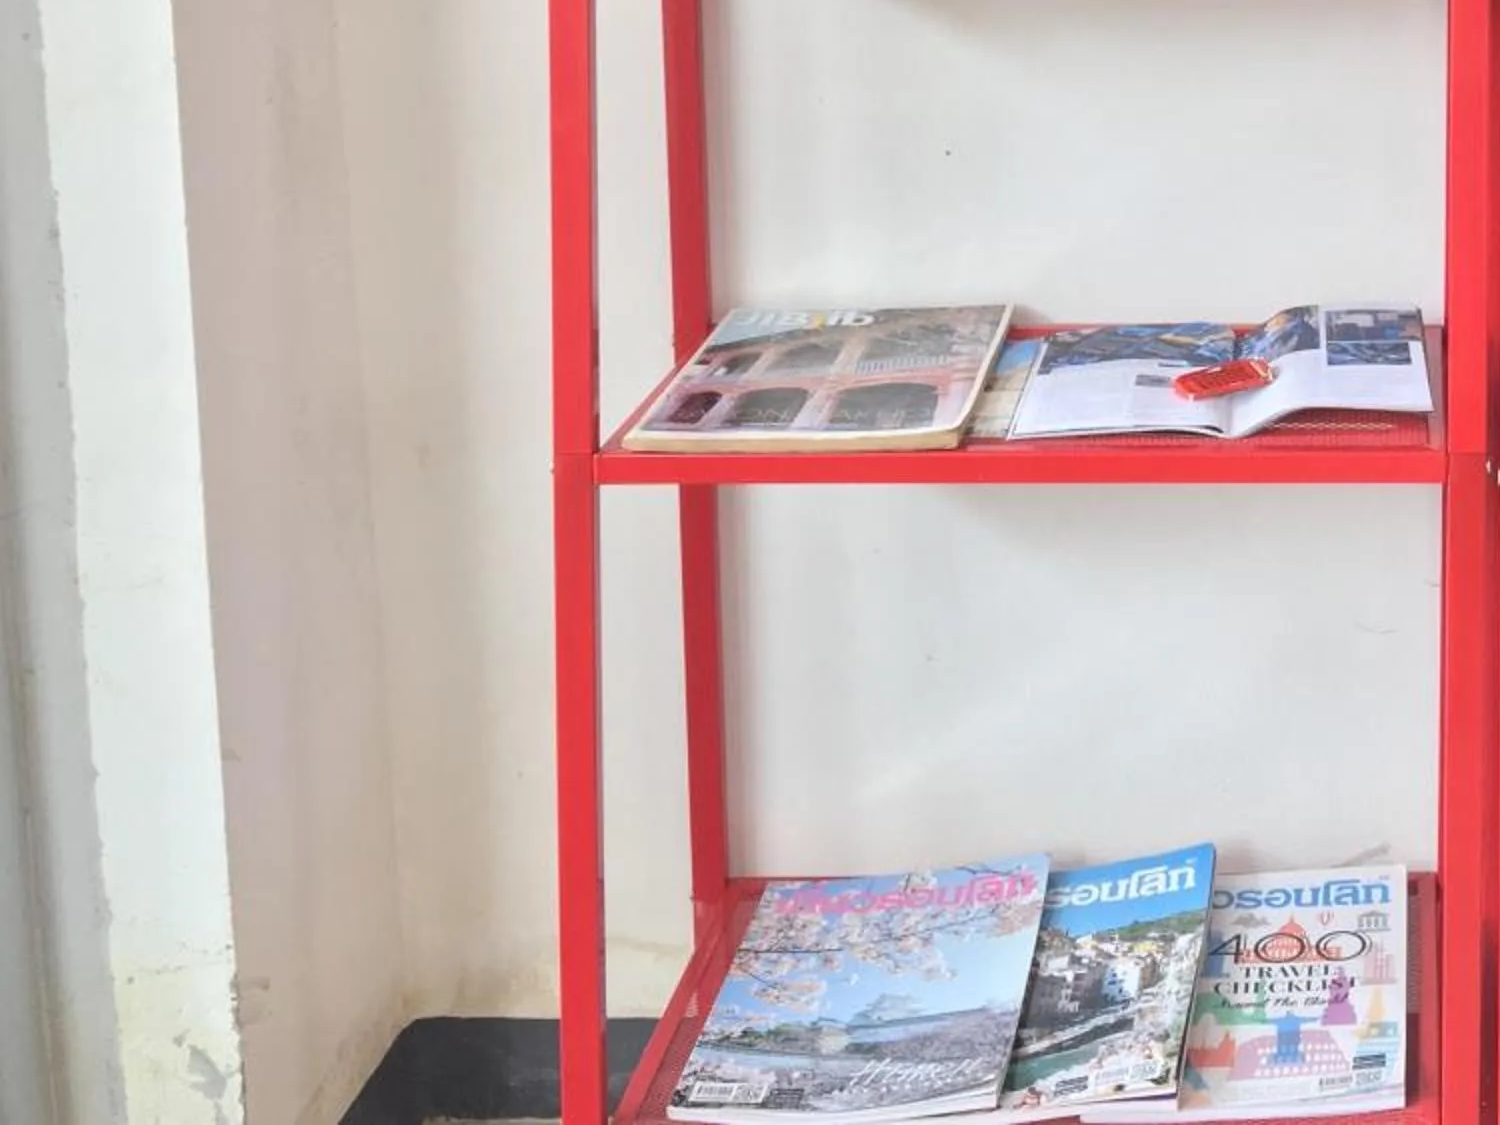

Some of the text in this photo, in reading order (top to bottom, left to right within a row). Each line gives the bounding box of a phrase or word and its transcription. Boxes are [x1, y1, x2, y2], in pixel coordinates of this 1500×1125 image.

[1209, 930, 1370, 964] 400
[1239, 964, 1335, 979] TRAVEL
[1213, 976, 1358, 995] CHECKLIST
